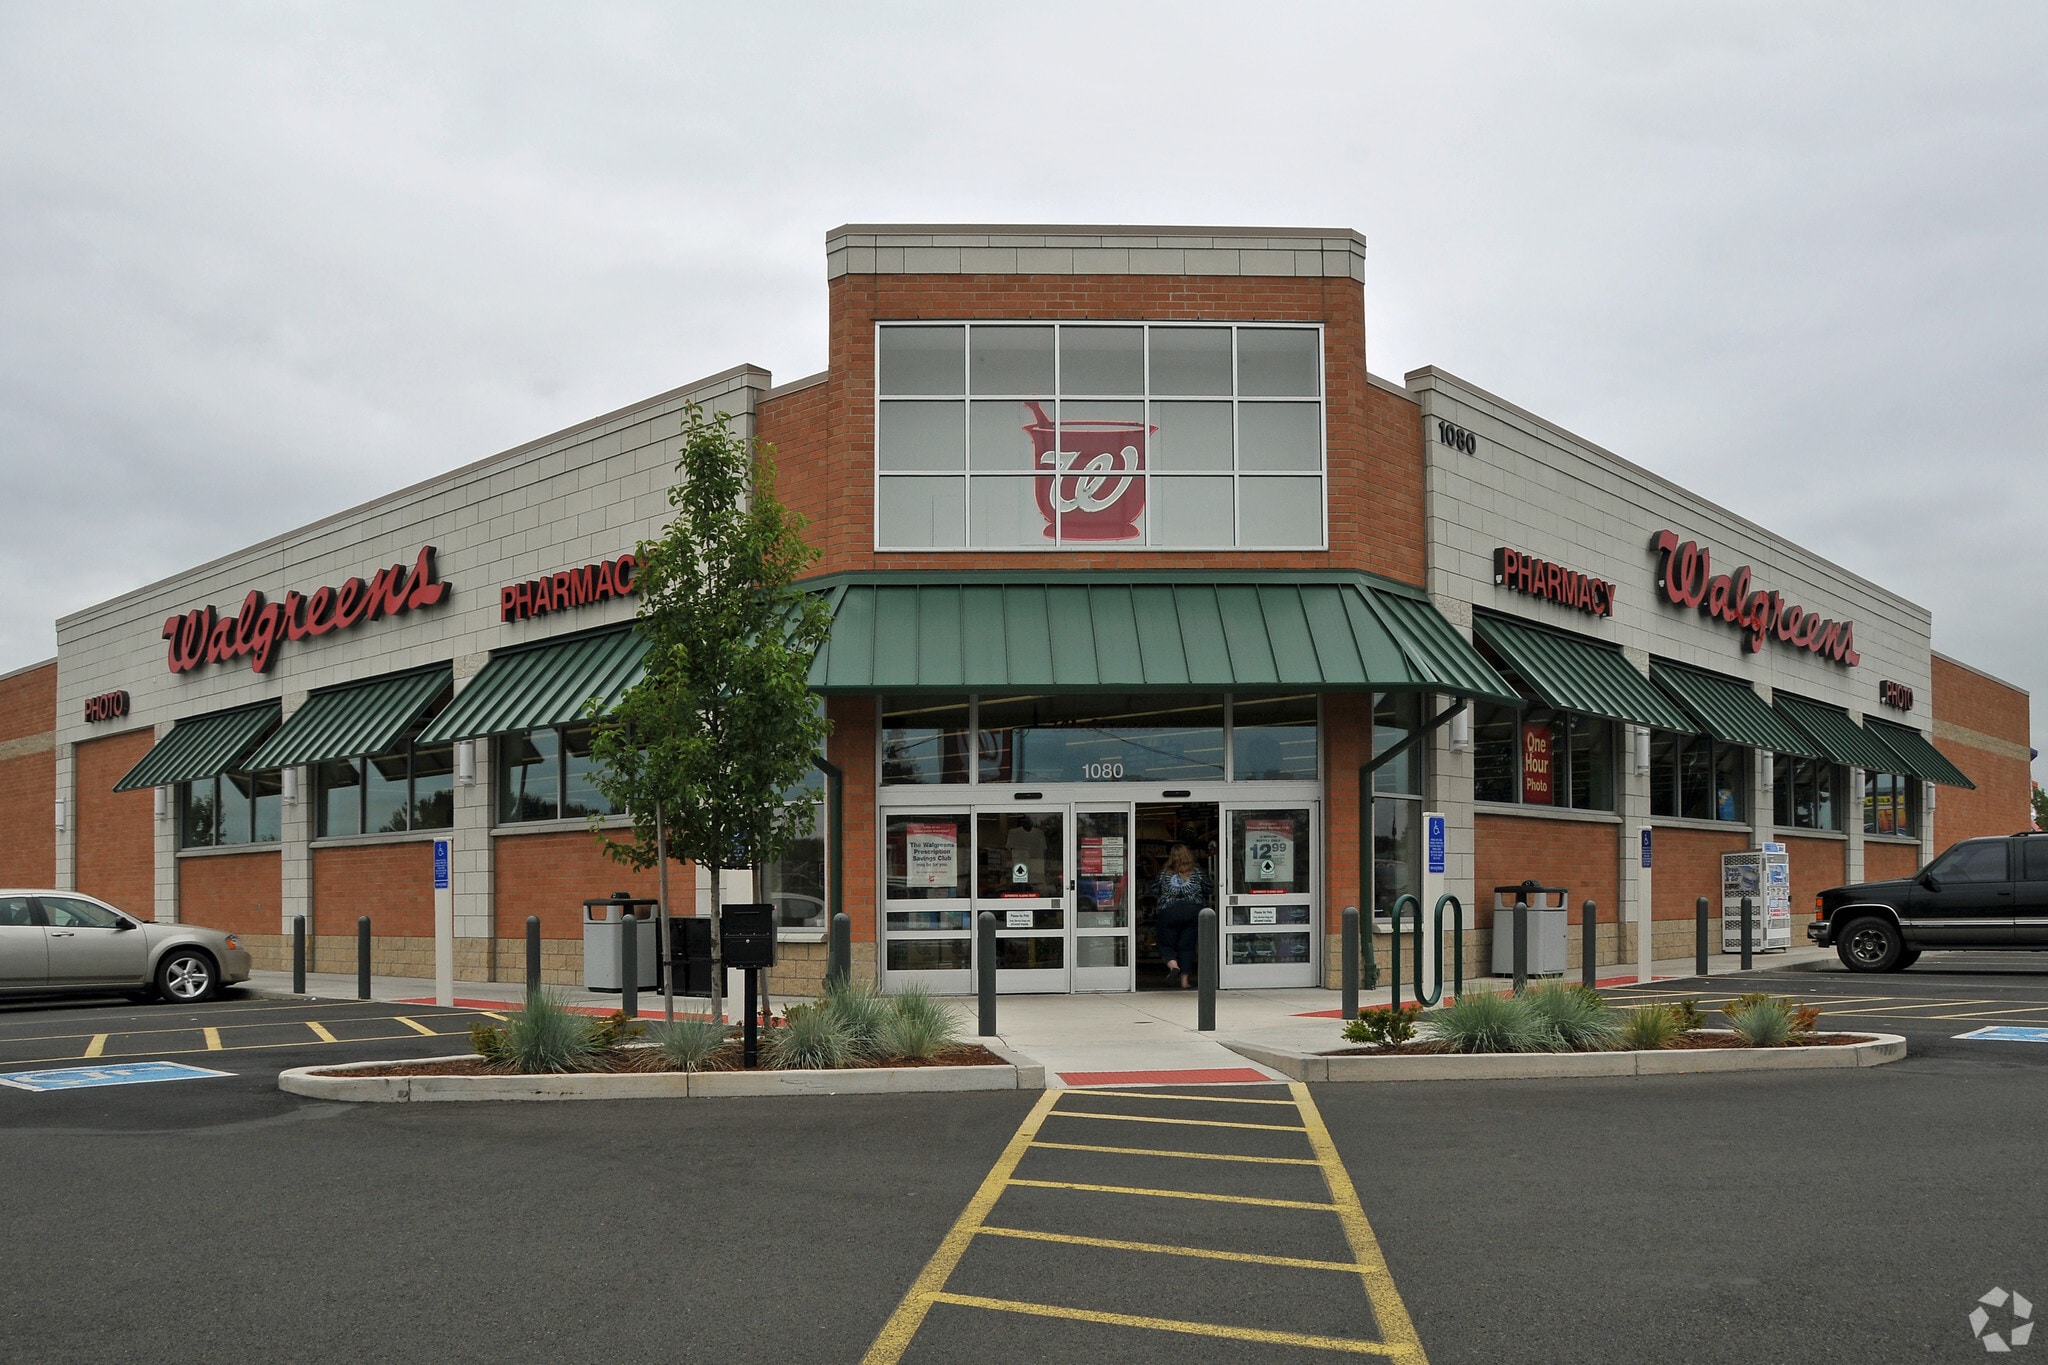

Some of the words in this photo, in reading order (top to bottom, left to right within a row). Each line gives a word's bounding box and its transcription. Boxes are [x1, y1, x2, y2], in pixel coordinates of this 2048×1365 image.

[1438, 420, 1477, 455] 1080
[501, 550, 650, 623] PHARMAC
[1502, 546, 1617, 618] PHARMACY
[1655, 529, 1861, 667] Walgreens
[162, 545, 452, 674] Walgreens
[84, 689, 126, 723] PHOTO
[1885, 680, 1914, 711] PHOTO
[1527, 731, 1547, 753] One
[1081, 763, 1124, 779] 1080
[1525, 752, 1549, 774] Hour
[1526, 777, 1548, 792] Photo
